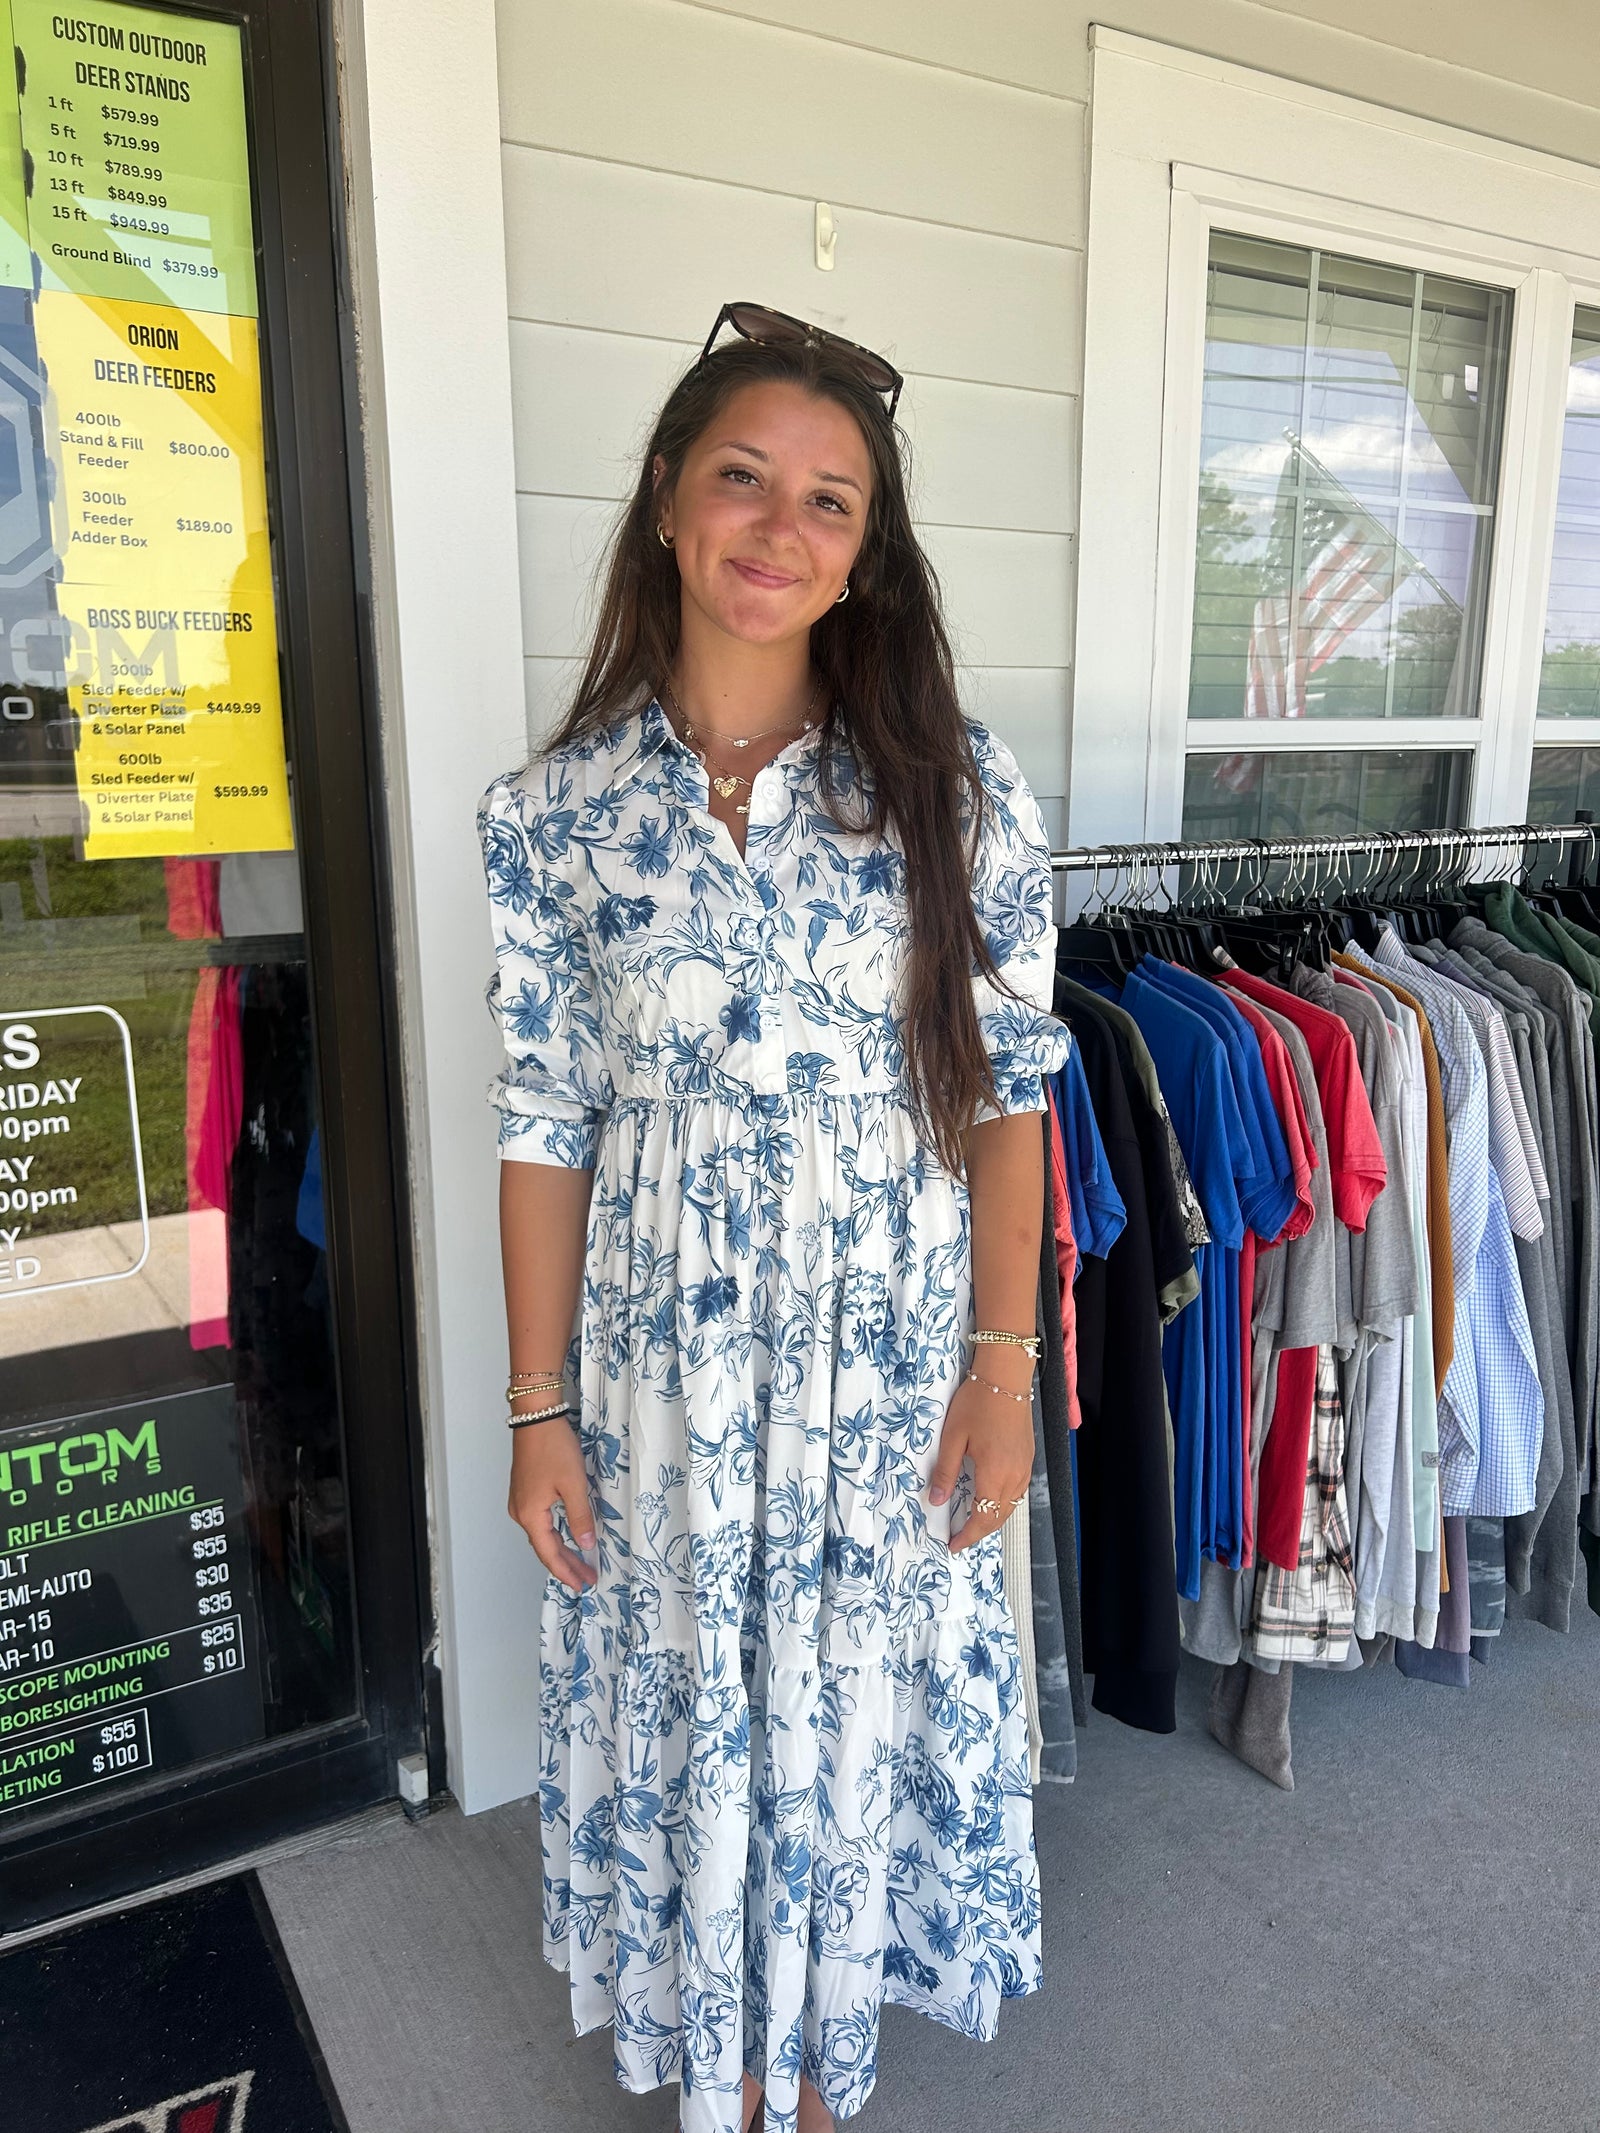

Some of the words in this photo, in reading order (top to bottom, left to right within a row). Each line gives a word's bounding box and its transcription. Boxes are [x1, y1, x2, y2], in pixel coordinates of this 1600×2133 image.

[52, 16, 125, 51] CUSTOM
[129, 32, 207, 66] OUTDOOR
[75, 61, 121, 91] DEER
[125, 71, 190, 103] STANDS
[48, 97, 57, 108] 1
[60, 99, 74, 112] ft
[101, 105, 159, 127] $579.99
[51, 124, 60, 136] 5
[63, 126, 77, 140] ft
[103, 132, 160, 153] $719.99
[48, 150, 67, 164] 10
[70, 153, 84, 167] ft
[104, 160, 163, 182] $789.99
[50, 178, 68, 192] 13
[71, 180, 85, 194] ft
[108, 186, 167, 208] $849.99
[52, 206, 71, 219] 15
[74, 207, 88, 222] ft
[110, 213, 170, 235] $949.99
[51, 243, 109, 264] Ground
[113, 252, 152, 269] Blind
[162, 259, 219, 279] $379.99
[128, 324, 179, 351] ORION
[94, 359, 139, 385] DEER
[143, 364, 216, 394] FEEDERS
[75, 412, 121, 427] 400lb
[59, 430, 104, 447] Stand
[107, 436, 118, 448] &
[121, 437, 144, 451] Fill
[169, 441, 230, 459] $800.00
[78, 453, 129, 469] Feeder
[82, 491, 127, 506] 300lb
[82, 512, 134, 527] Feeder
[176, 517, 233, 534] $189.00
[71, 531, 117, 546] Adder
[121, 536, 148, 548] Box
[87, 608, 131, 629] BOSS
[136, 610, 180, 630] BUCK
[184, 612, 253, 632] FEEDERS
[110, 663, 153, 677] 300lb
[82, 684, 114, 696] Sled
[118, 684, 166, 697] Feeder
[170, 684, 187, 698] w/
[87, 703, 146, 716] Diverter
[151, 703, 186, 716] Plate
[207, 702, 261, 714] $449.99
[92, 724, 102, 735] &
[105, 723, 142, 735] Solar
[147, 723, 185, 735] Panel
[119, 753, 162, 766] 600lb
[91, 773, 123, 785] Sled
[127, 772, 174, 785] Feeder
[178, 770, 195, 784] w/
[97, 791, 155, 805] Diverter
[159, 791, 194, 803] Plate
[214, 785, 268, 798] $599.99
[101, 813, 111, 824] &
[114, 811, 150, 823] Solar
[155, 809, 193, 822] Panel
[0, 1115, 70, 1143] 0pm
[8, 1515, 71, 1547] RIFLE
[77, 1485, 195, 1529] CLEANING
[190, 1506, 224, 1530] $35
[193, 1534, 227, 1560] $55
[195, 1563, 230, 1588] $30
[198, 1591, 232, 1616] $35
[0, 1673, 59, 1704] SCOPE
[64, 1642, 170, 1686] MOUNTING
[201, 1622, 235, 1648] $25
[1, 1677, 144, 1732] BORESIGHTING
[203, 1648, 237, 1673] $10
[101, 1718, 136, 1744] $55
[92, 1743, 139, 1773] $100
